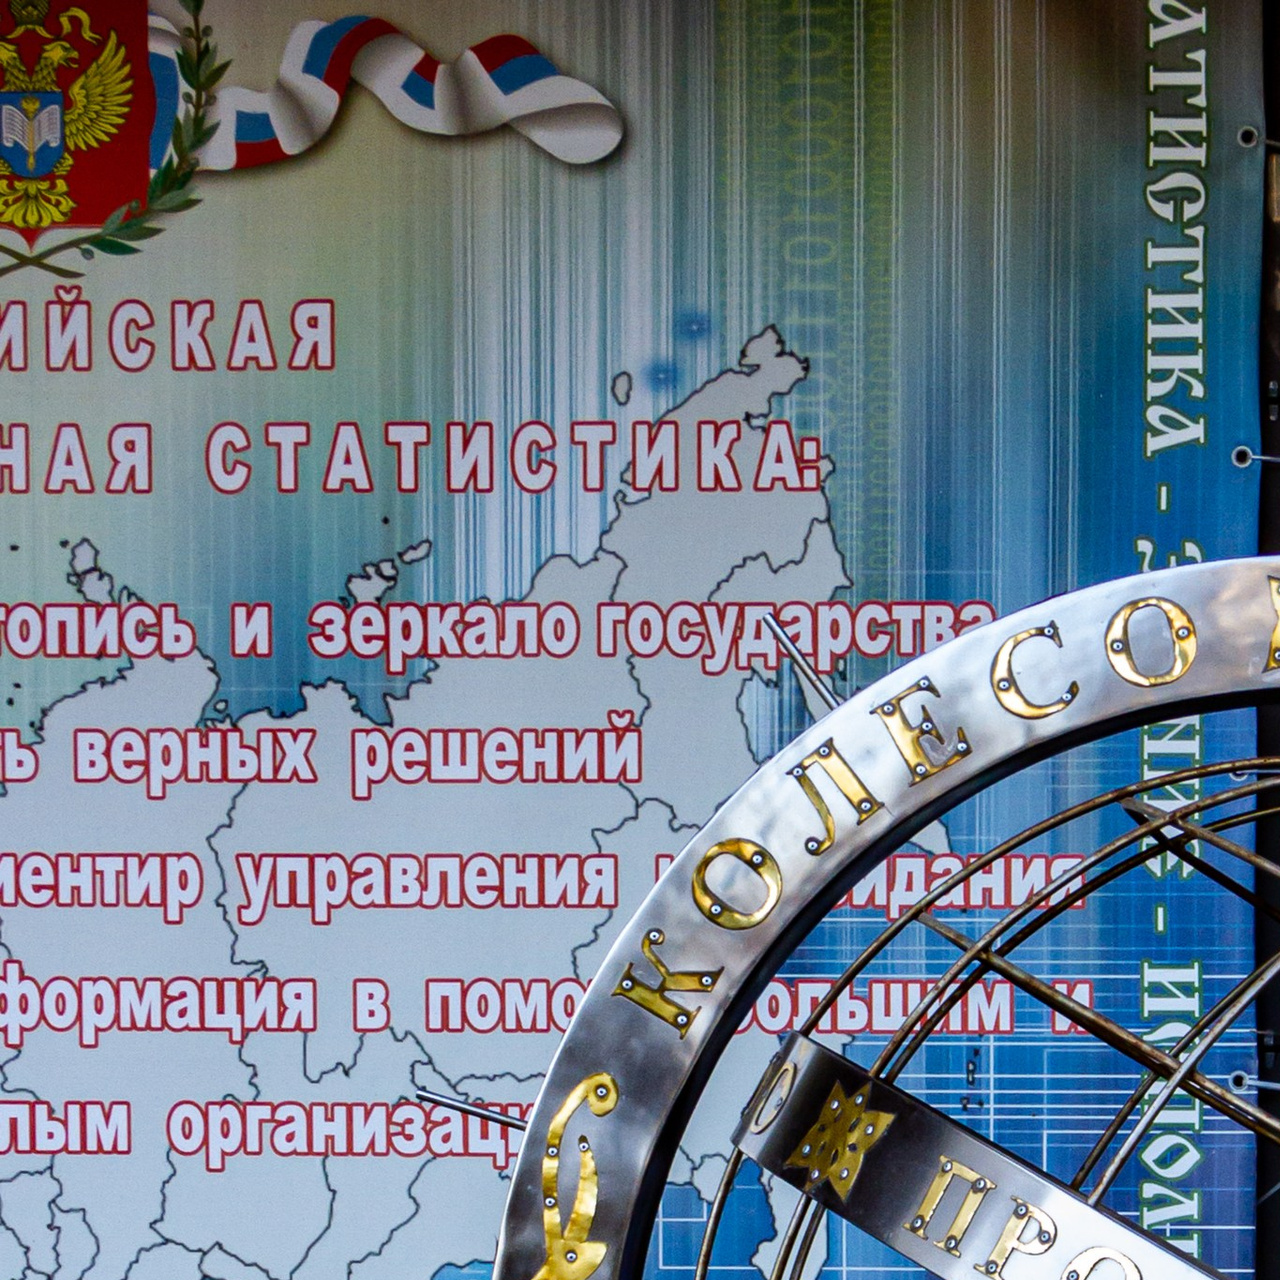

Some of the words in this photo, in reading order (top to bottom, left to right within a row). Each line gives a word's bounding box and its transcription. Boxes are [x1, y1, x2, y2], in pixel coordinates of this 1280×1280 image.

[205, 420, 822, 494] СТАТИСТИКА:
[230, 602, 272, 657] и
[308, 602, 580, 674] зеркало
[74, 727, 317, 800] верных
[351, 710, 642, 800] решений
[612, 597, 1198, 1039] КОЛЕСО
[237, 852, 619, 926] управления
[352, 979, 391, 1032] в
[425, 977, 598, 1034] помо
[1052, 979, 1094, 1035] и
